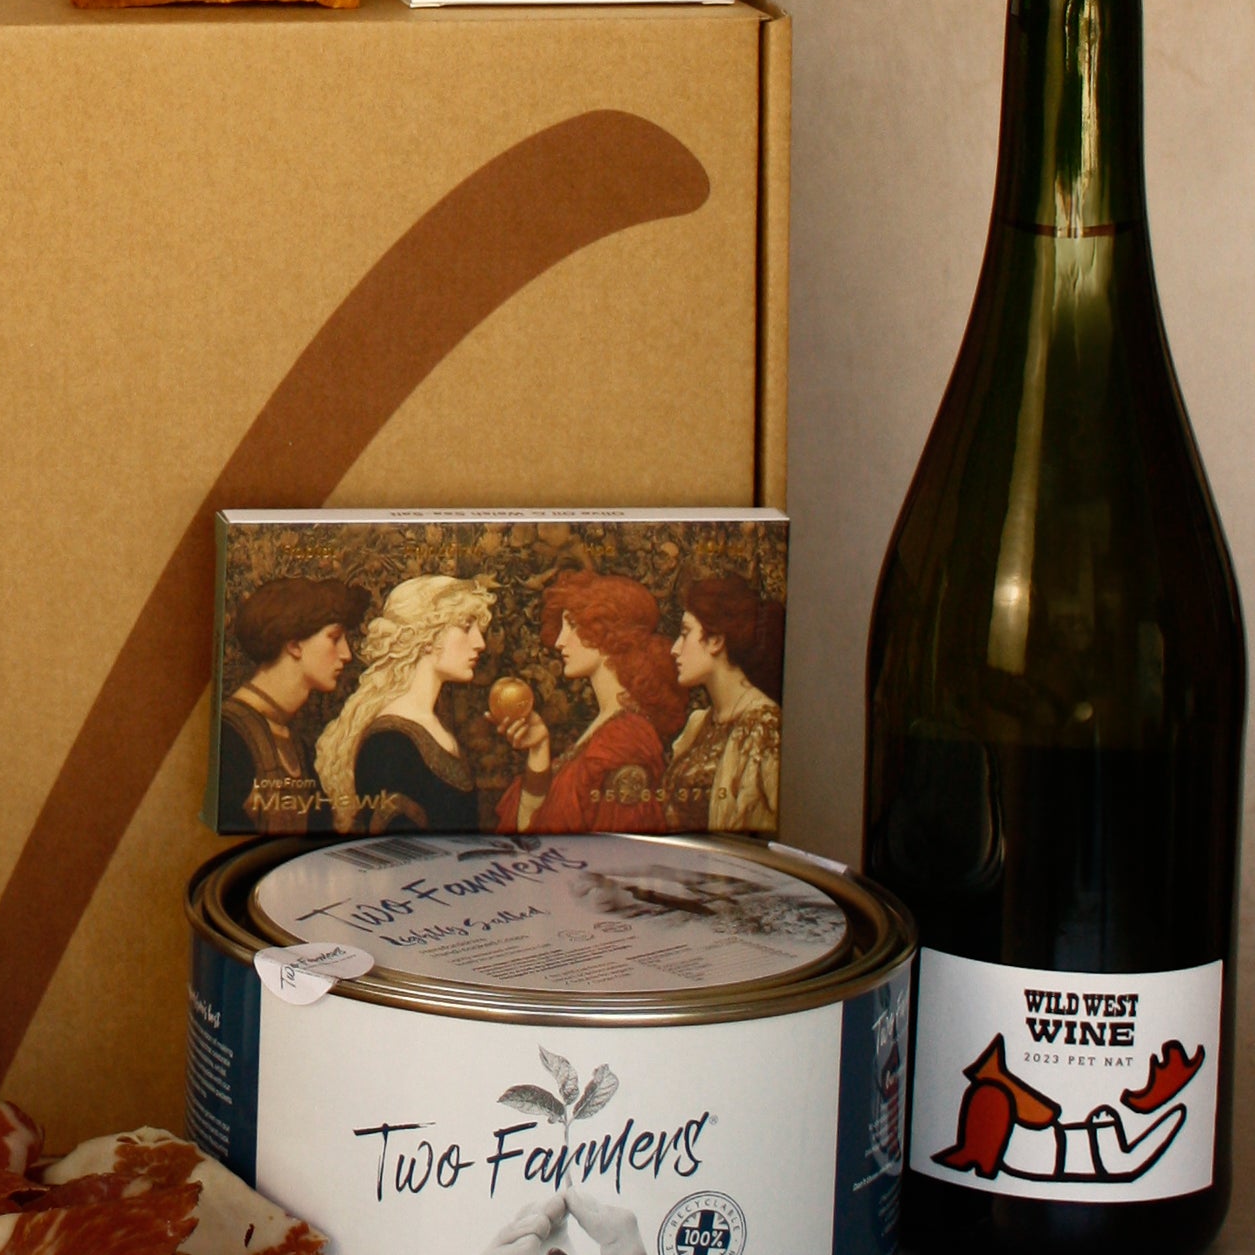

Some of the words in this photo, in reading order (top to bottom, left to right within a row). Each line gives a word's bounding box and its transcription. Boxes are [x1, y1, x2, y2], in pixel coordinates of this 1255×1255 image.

[252, 789, 400, 815] MayHawk
[296, 897, 414, 932] Two
[402, 847, 588, 905] Farmers
[1024, 989, 1080, 1016] WILD
[1082, 992, 1139, 1018] WEST
[1025, 1017, 1135, 1047] WINE
[1024, 1051, 1060, 1065] 2023
[1067, 1055, 1096, 1066] PET
[1104, 1056, 1134, 1067] NAT
[352, 1119, 477, 1202] Two
[487, 1111, 710, 1199] Farmers
[684, 1229, 724, 1248] 100%
